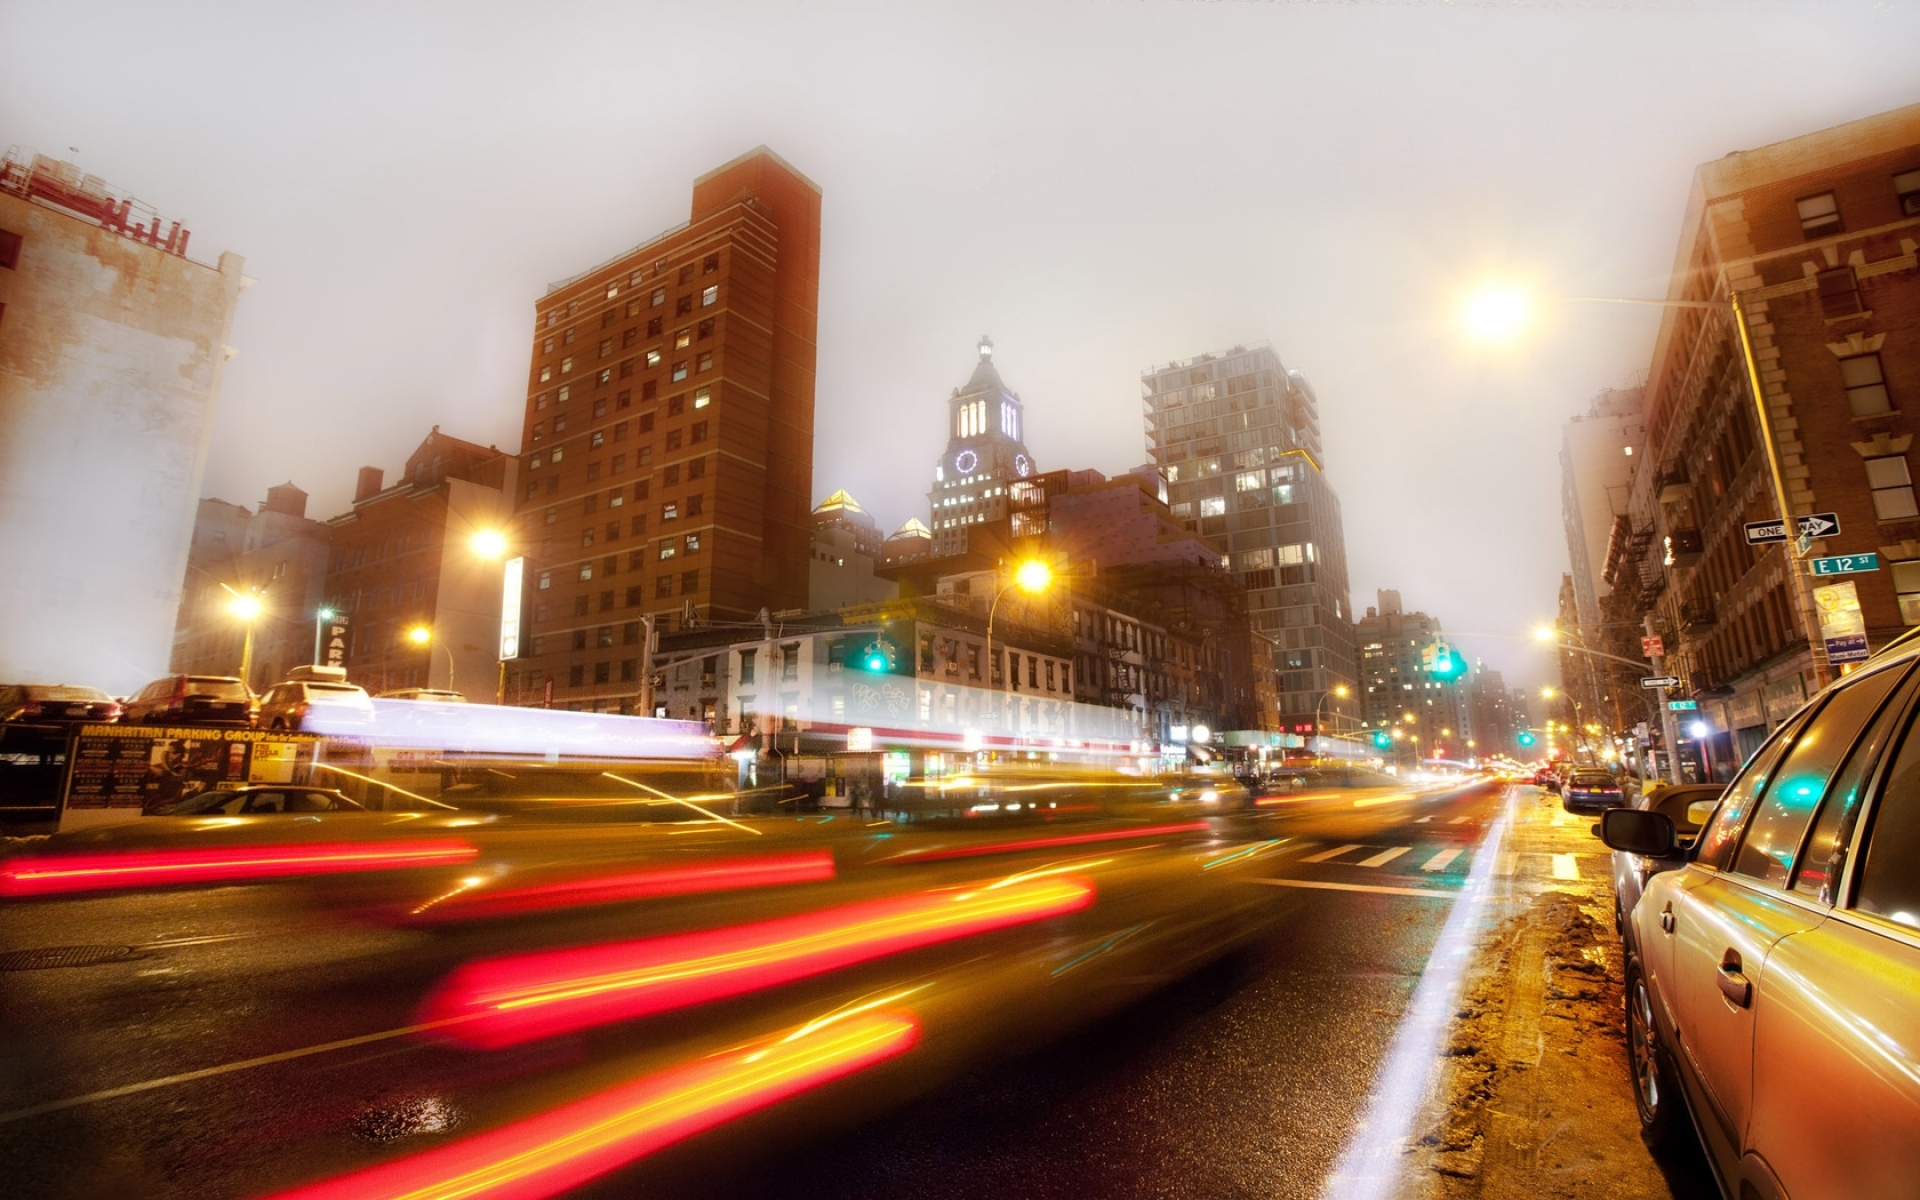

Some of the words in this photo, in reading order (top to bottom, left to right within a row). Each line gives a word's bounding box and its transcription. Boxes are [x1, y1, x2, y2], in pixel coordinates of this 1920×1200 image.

[1758, 526, 1783, 537] ONE
[1799, 520, 1823, 533] WAY
[1819, 560, 1831, 573] E
[1836, 558, 1854, 571] 12
[1859, 556, 1870, 564] ST
[81, 725, 164, 738] MANHATTAN
[166, 728, 222, 741] PARKING
[223, 730, 266, 743] GROUP
